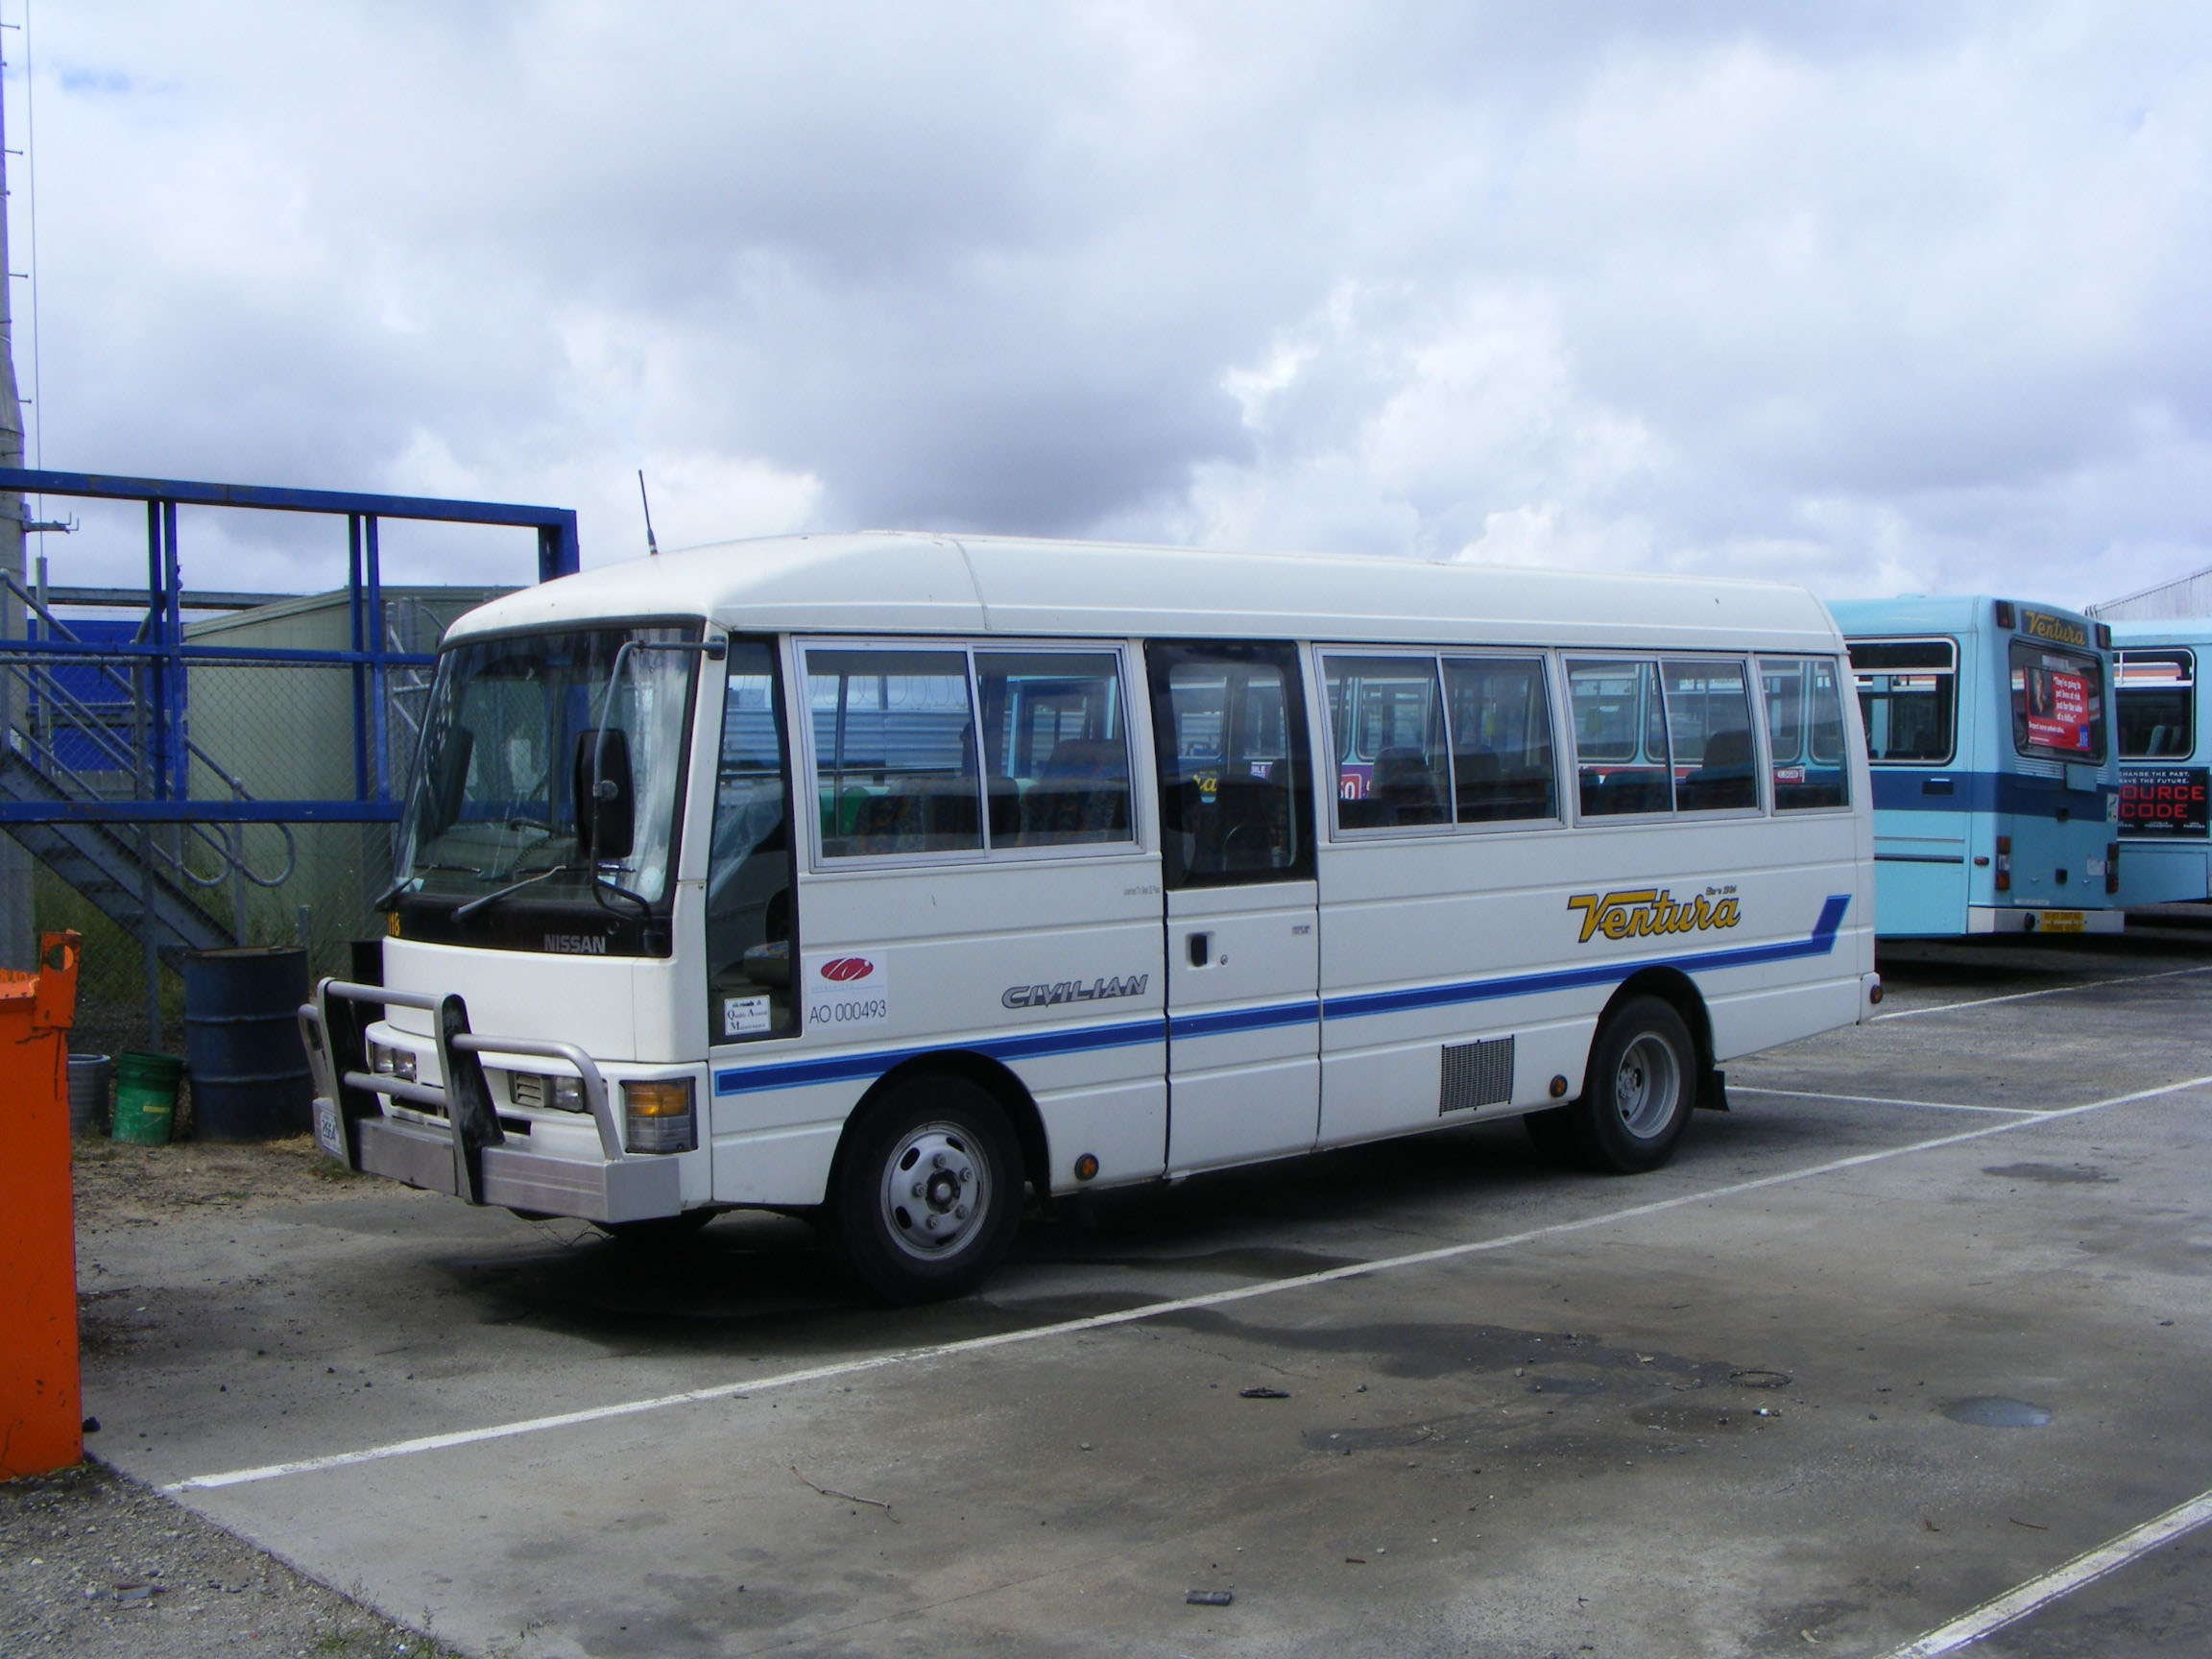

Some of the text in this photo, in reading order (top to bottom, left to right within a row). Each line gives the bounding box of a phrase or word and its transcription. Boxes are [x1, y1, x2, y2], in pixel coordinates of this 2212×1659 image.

[2025, 612, 2085, 646] Ventura
[2120, 804, 2188, 819] CODE
[1567, 888, 1741, 943] Ventura
[543, 933, 606, 953] NISSAN
[1001, 974, 1149, 1009] CIVILIAN
[808, 999, 887, 1024] AO 000493
